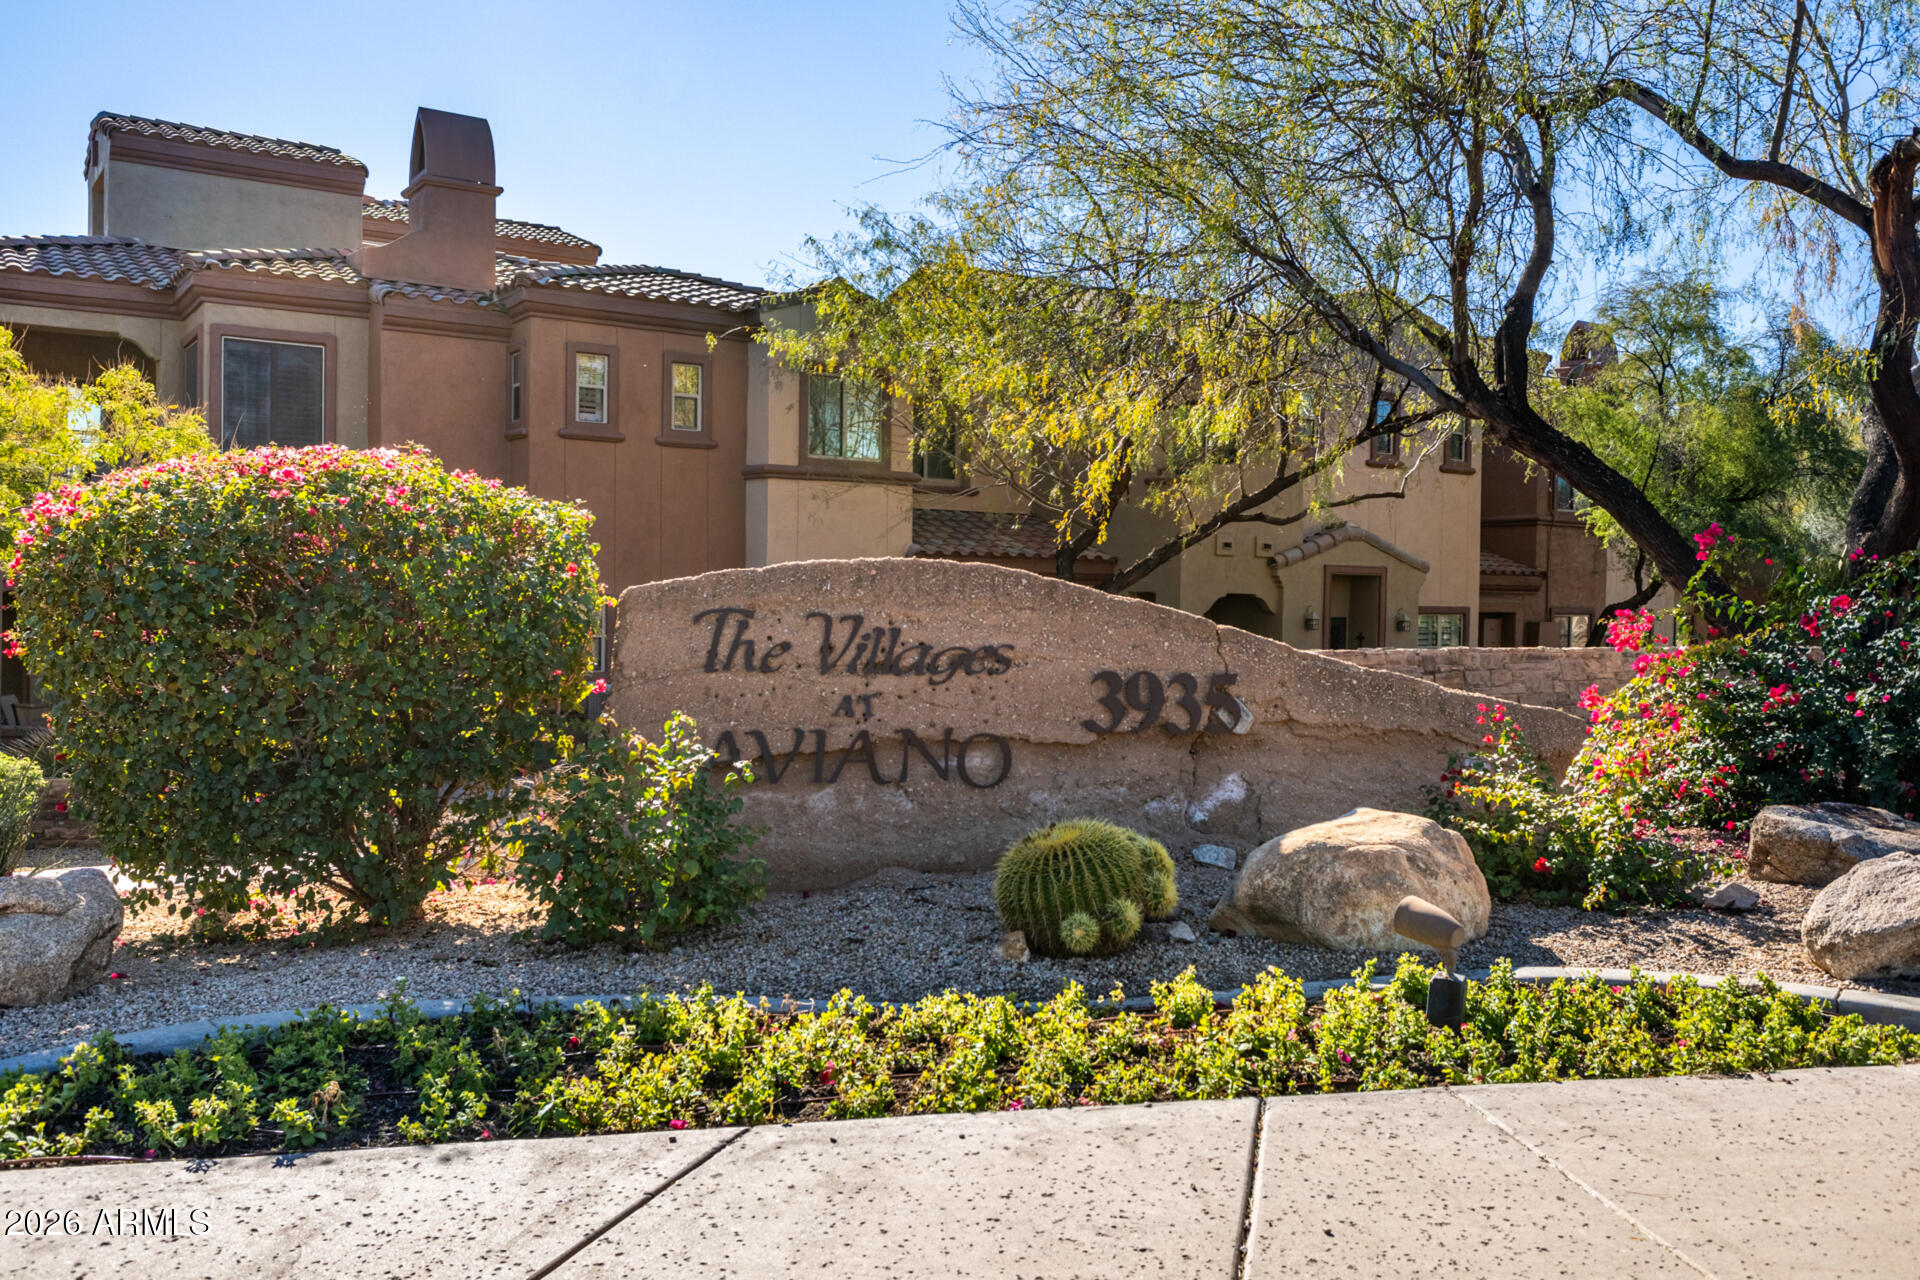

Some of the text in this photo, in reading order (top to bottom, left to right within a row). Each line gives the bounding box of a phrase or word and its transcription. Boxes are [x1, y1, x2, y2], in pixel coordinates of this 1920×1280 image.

[693, 607, 1015, 686] The Villages
[831, 692, 883, 718] AT
[1082, 670, 1243, 735] 3935
[709, 727, 1013, 789] AVIANO
